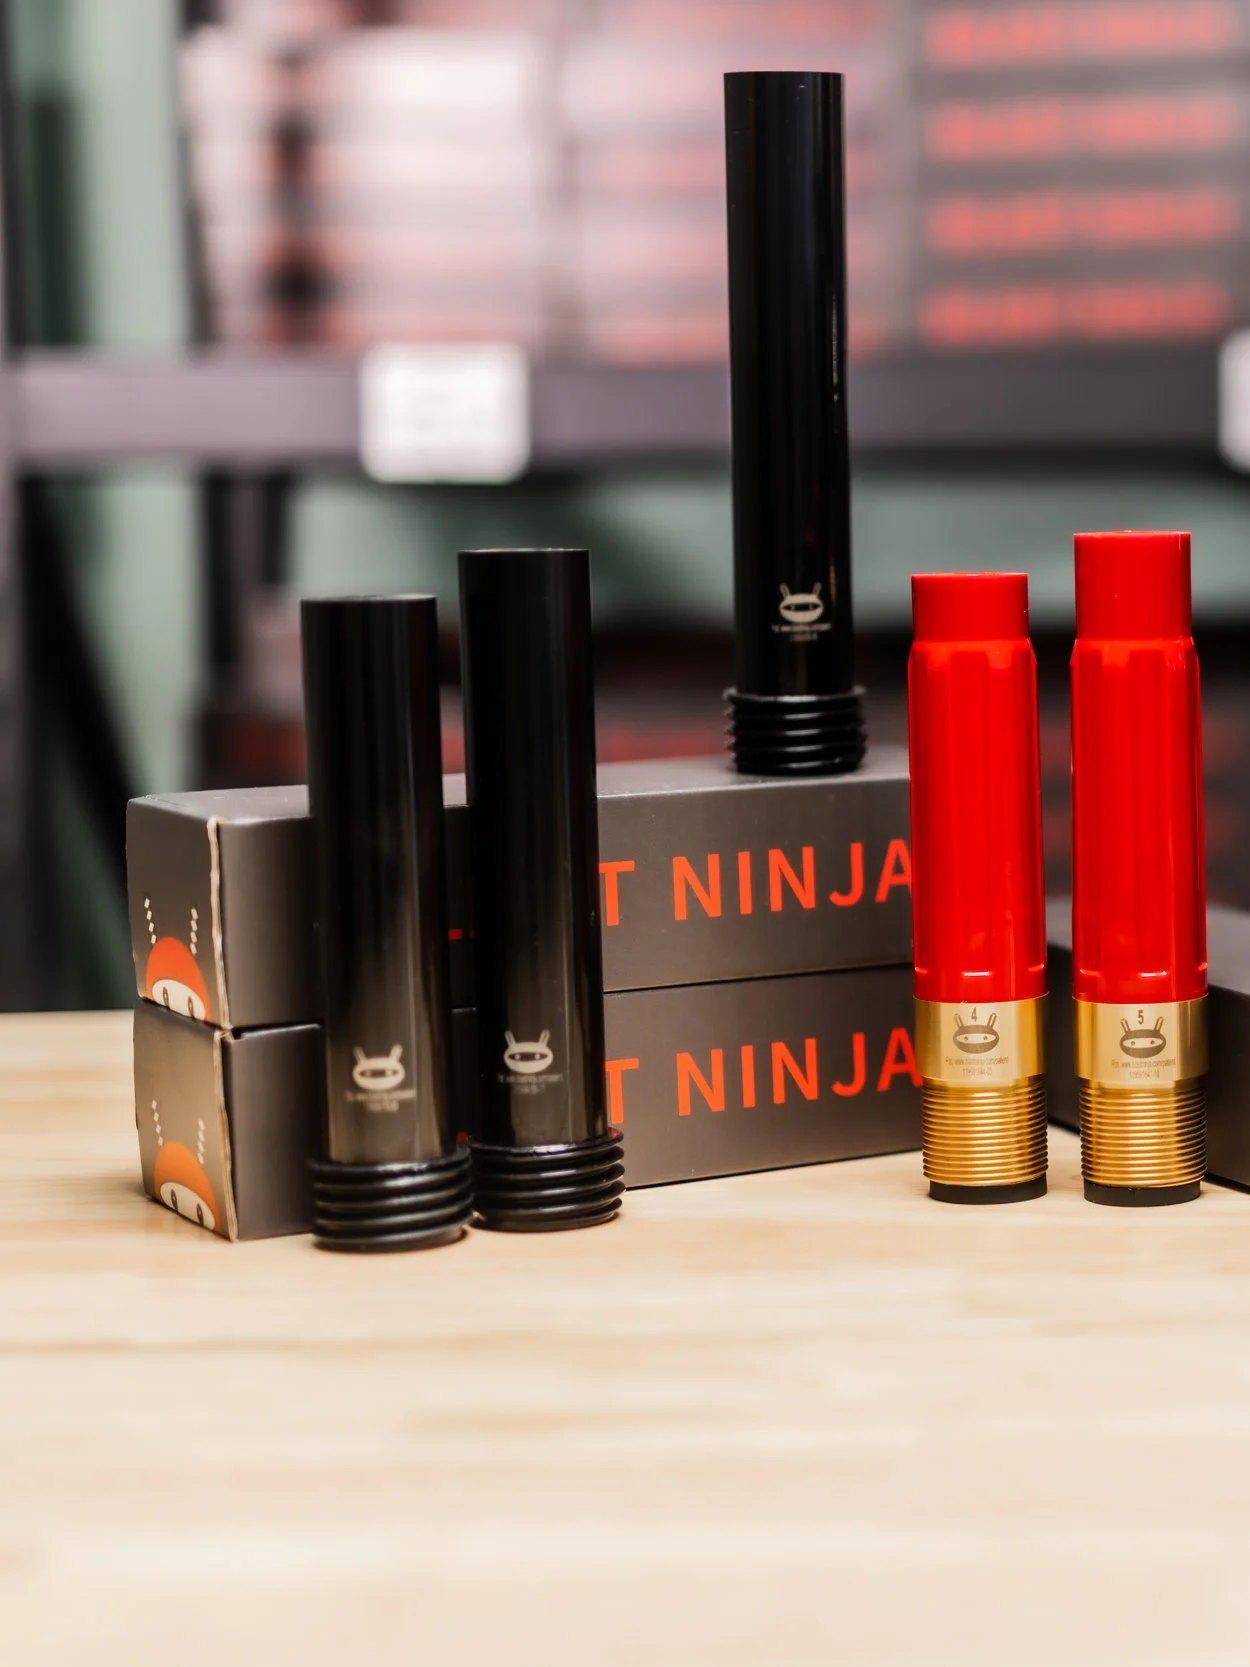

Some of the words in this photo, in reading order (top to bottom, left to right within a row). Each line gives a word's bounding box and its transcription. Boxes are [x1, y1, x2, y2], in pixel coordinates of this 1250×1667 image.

[672, 838, 912, 922] NINJA
[970, 1007, 978, 1022] 4
[1138, 1009, 1144, 1025] 5
[674, 1027, 923, 1118] NINJA
